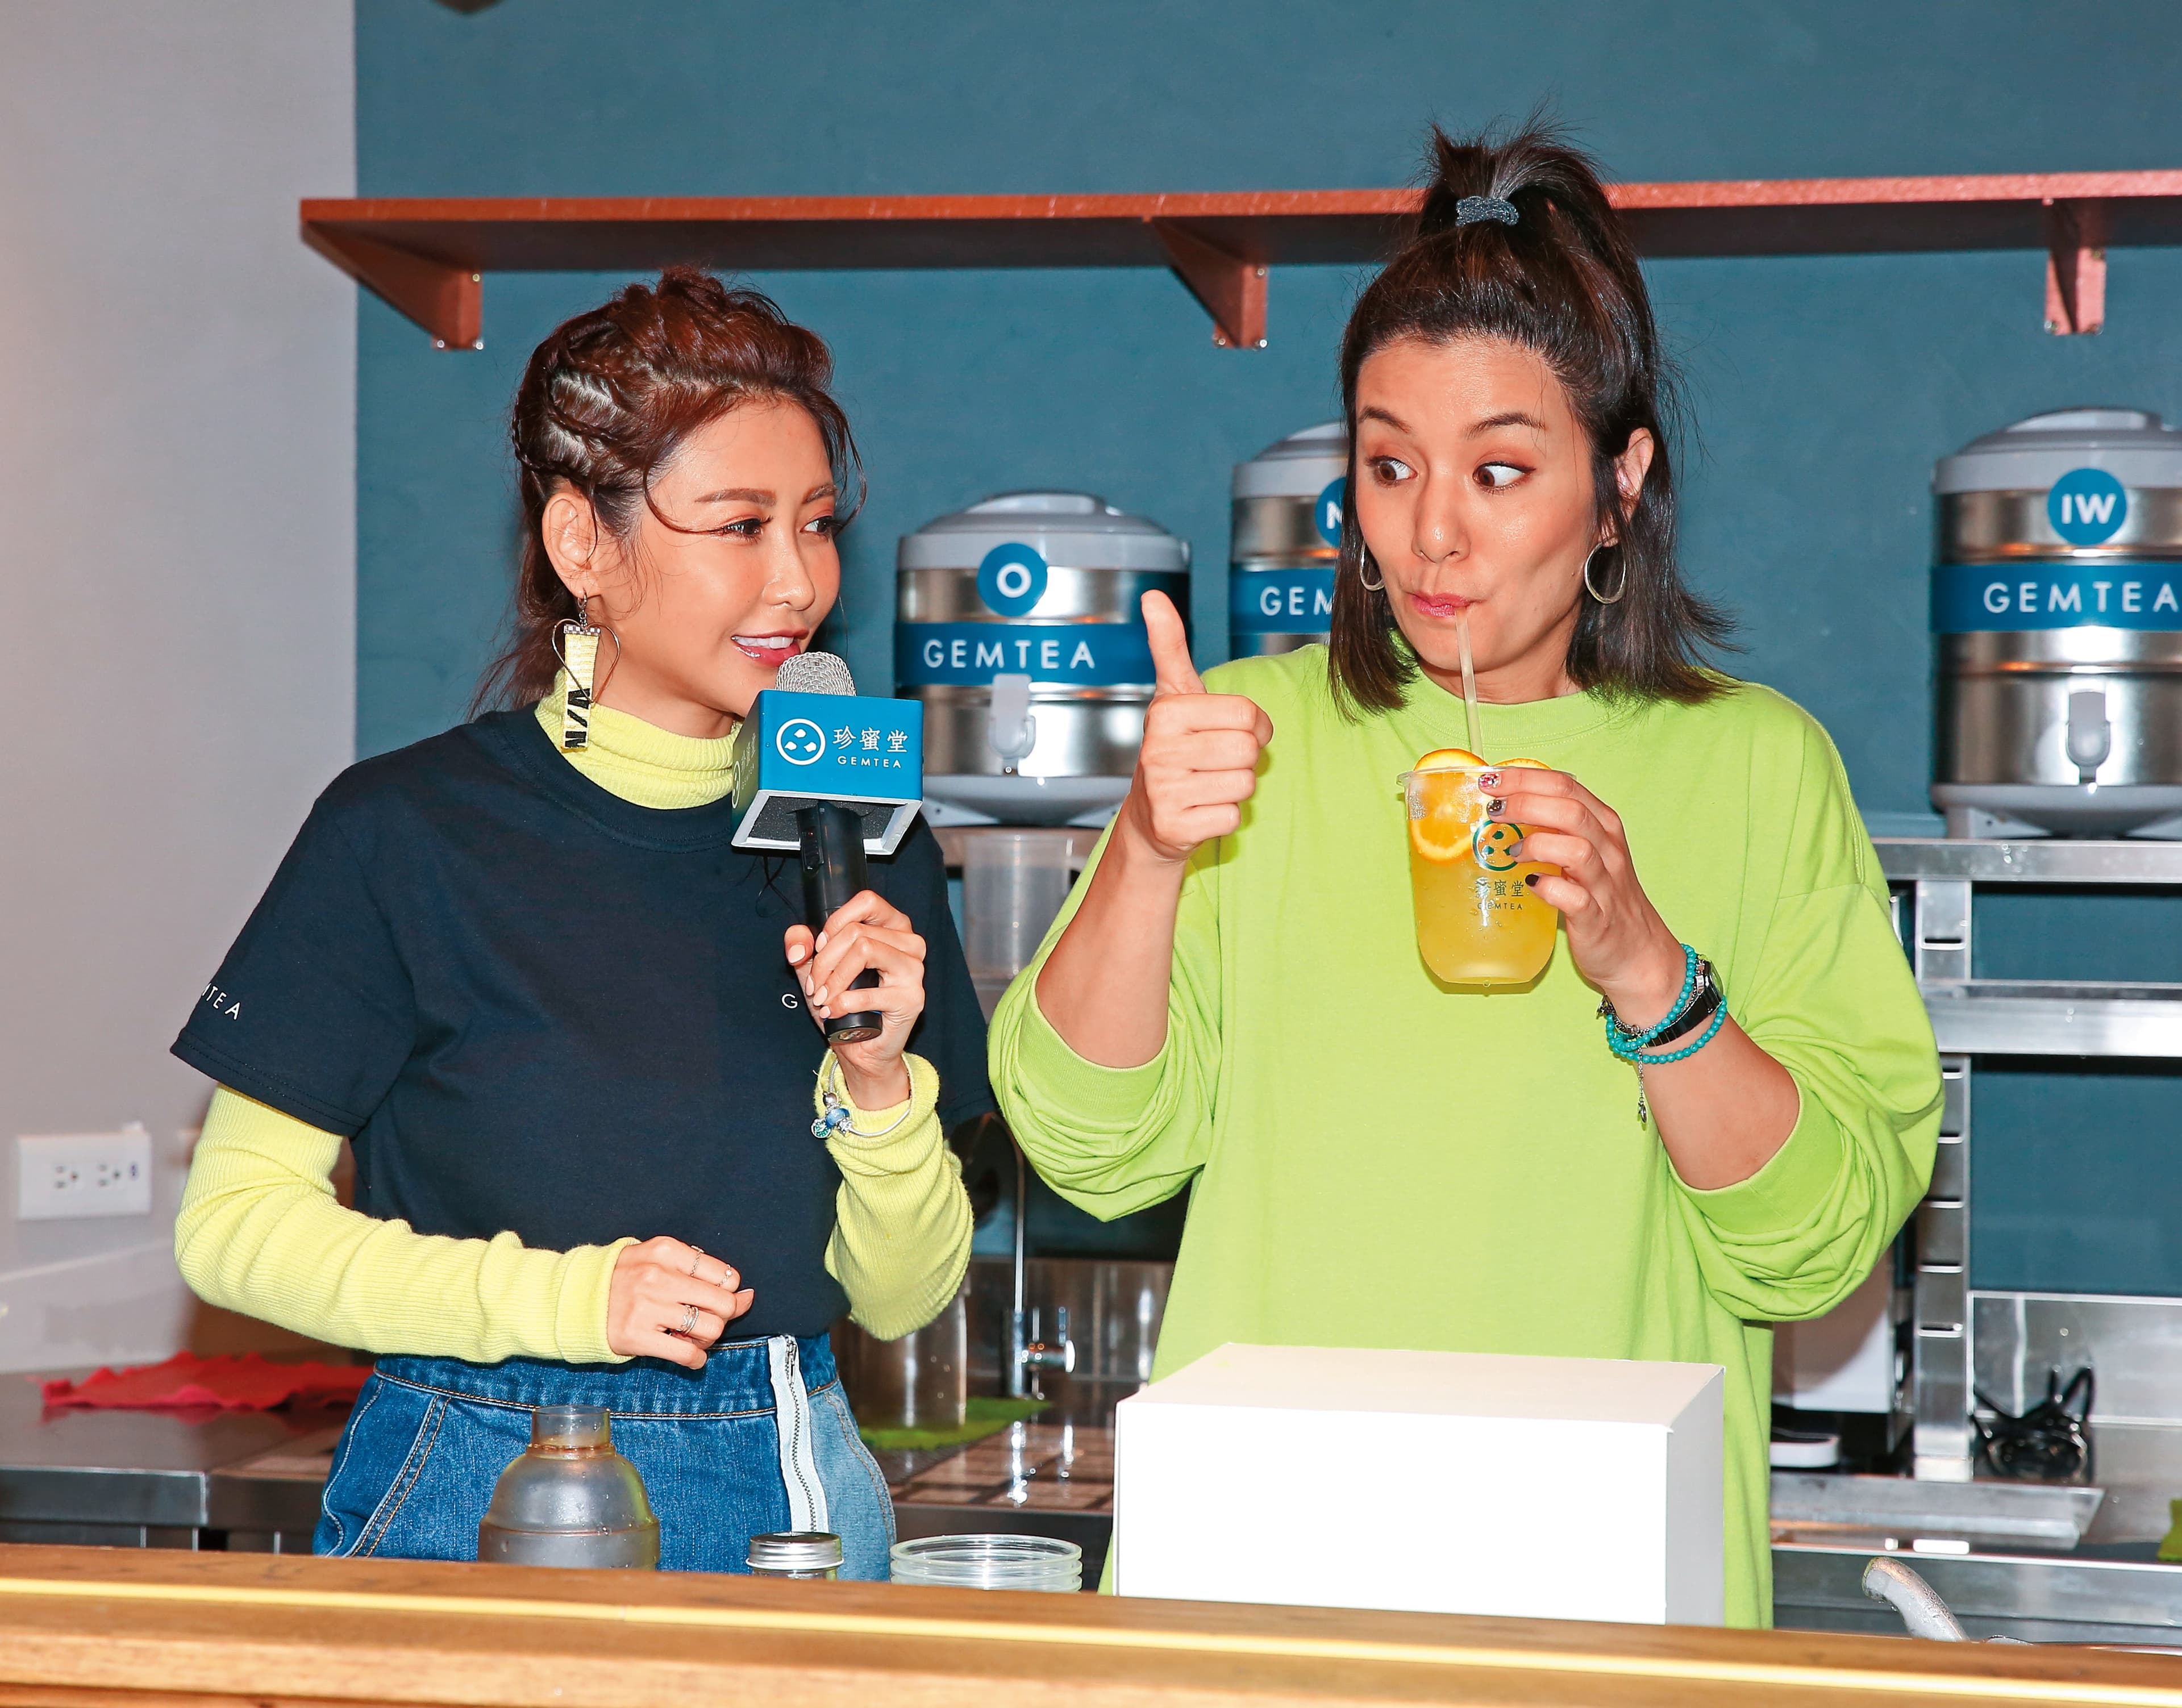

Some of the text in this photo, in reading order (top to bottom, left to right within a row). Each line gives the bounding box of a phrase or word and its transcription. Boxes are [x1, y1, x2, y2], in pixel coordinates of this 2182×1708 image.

[2061, 493, 2117, 524] IW
[996, 562, 1032, 598] O
[1983, 581, 2179, 614] GEMTEA
[923, 639, 1096, 669] GEMTEA
[832, 725, 909, 753] 珍蜜堂
[837, 755, 902, 769] GEMTEA
[202, 983, 240, 1020] TEA
